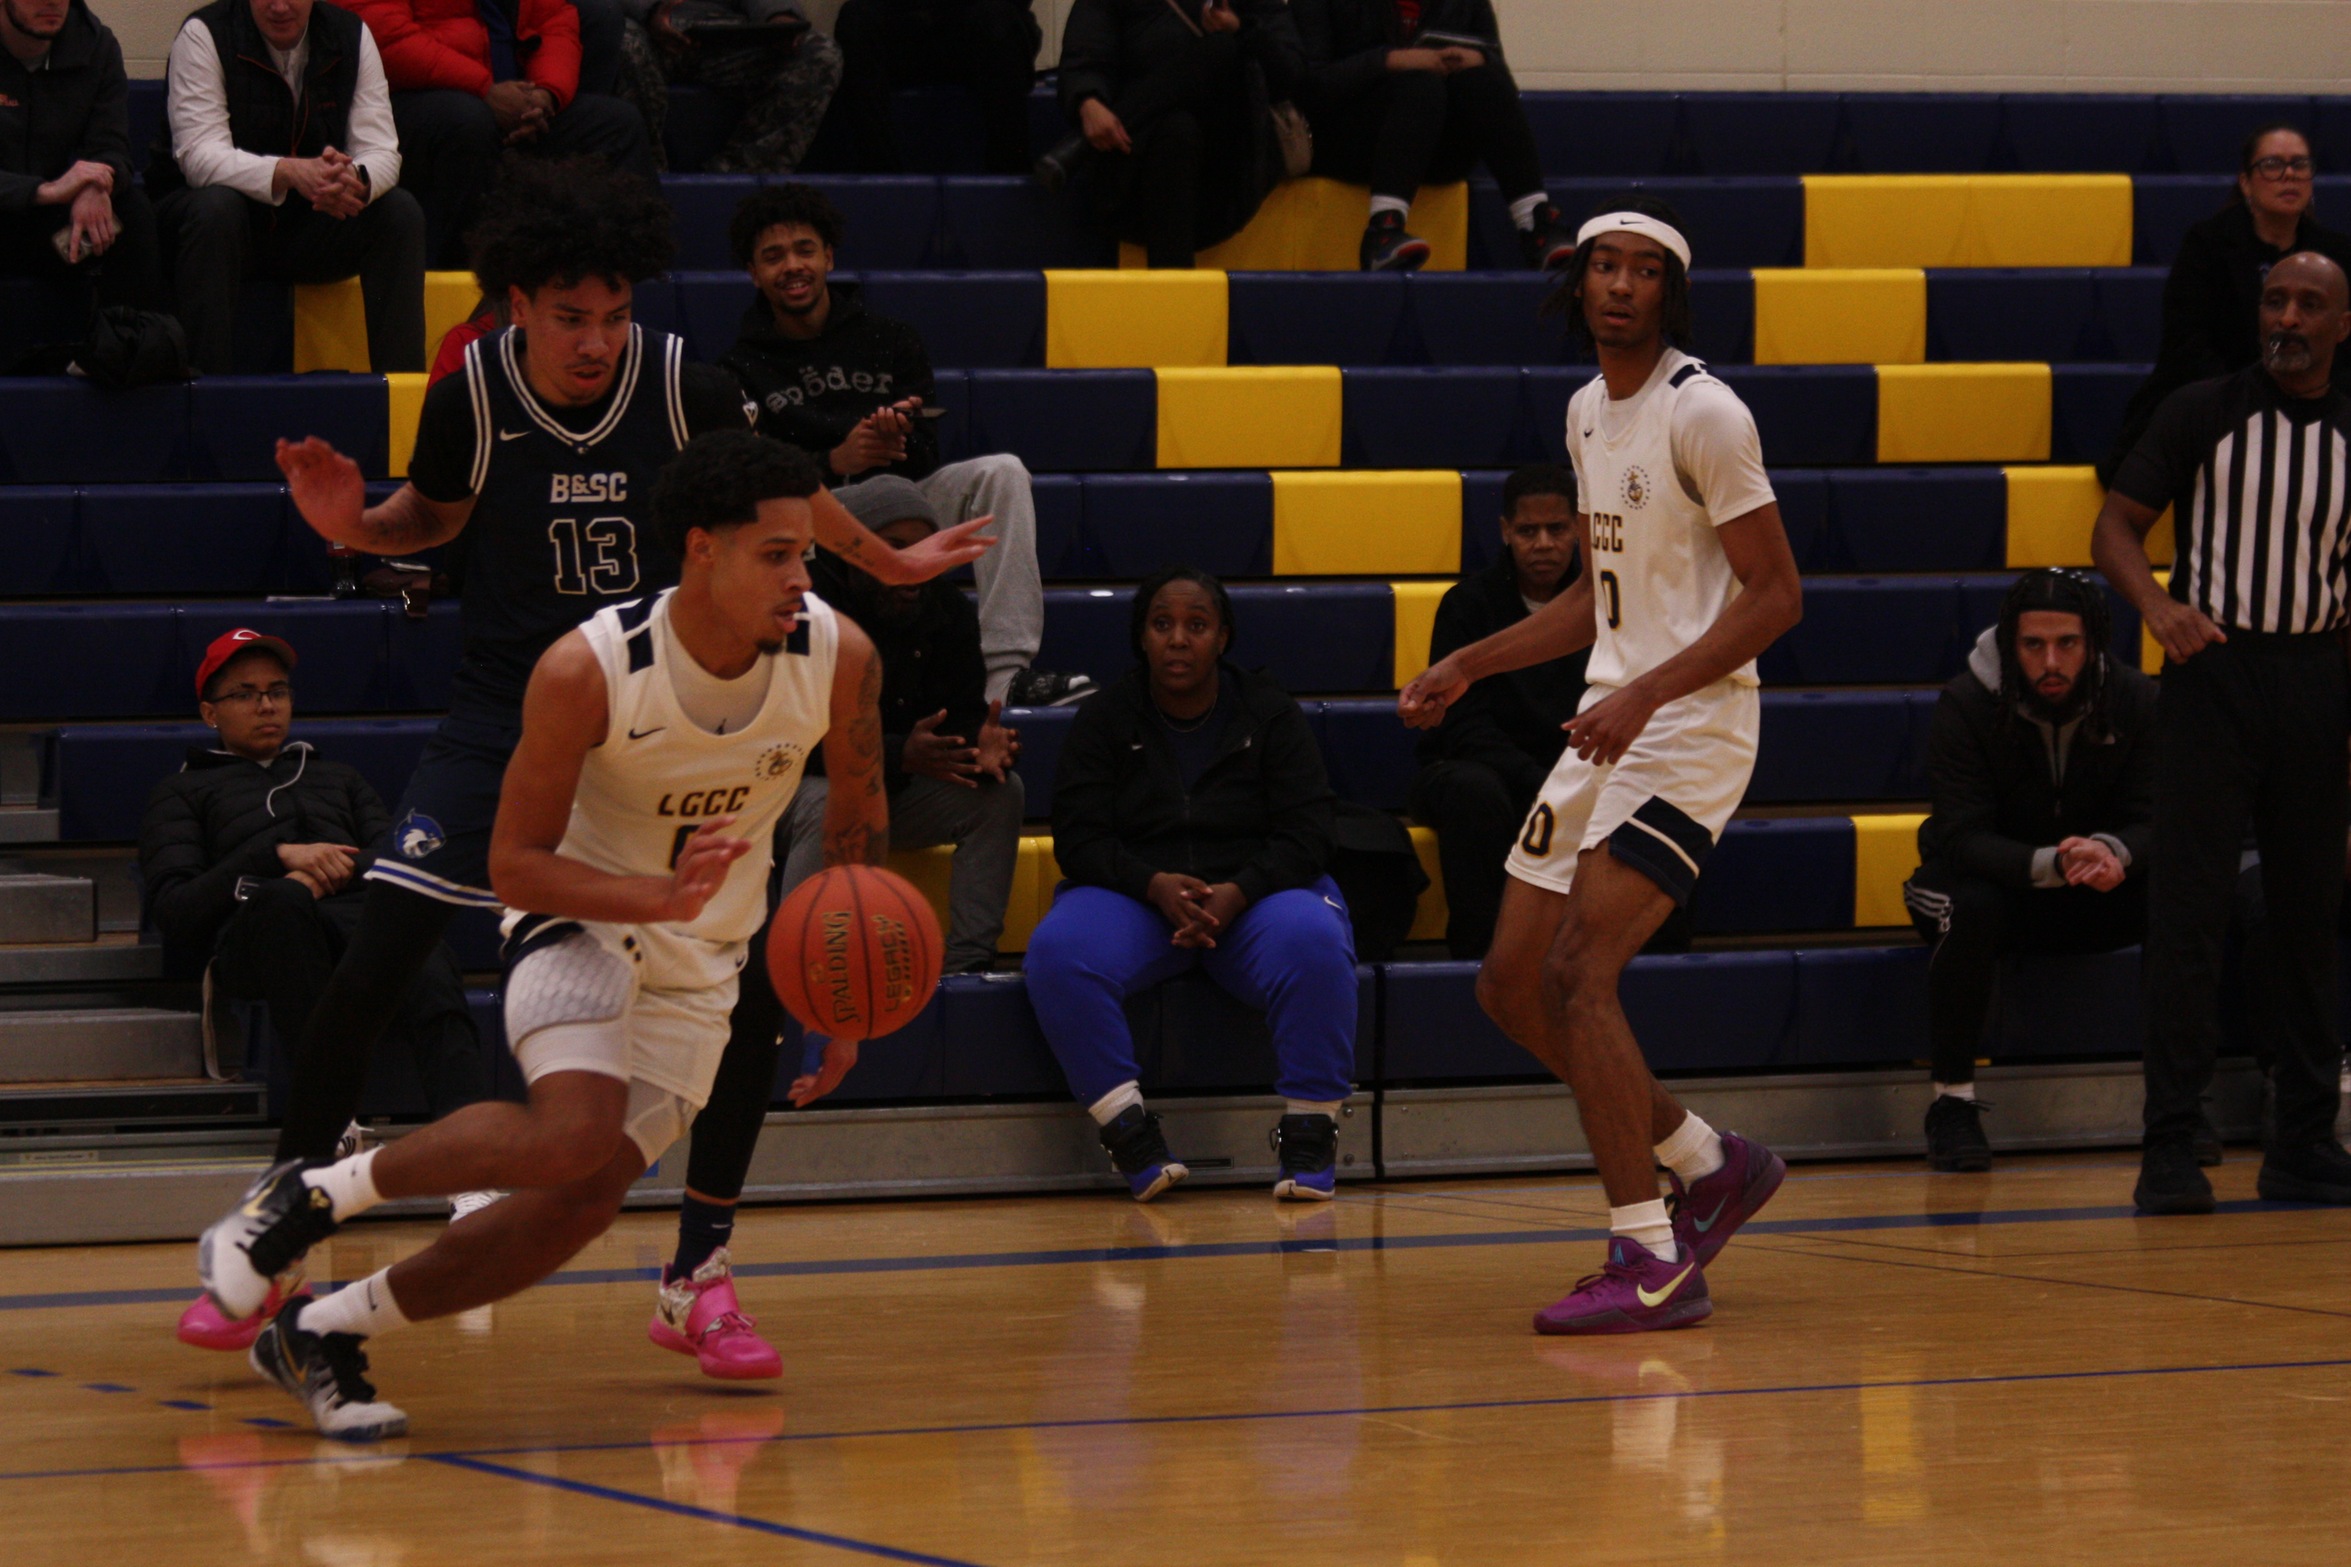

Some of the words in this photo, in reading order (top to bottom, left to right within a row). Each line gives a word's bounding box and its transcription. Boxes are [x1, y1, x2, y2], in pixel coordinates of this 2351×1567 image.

[549, 471, 629, 504] B&SC
[547, 516, 641, 595] 13
[1522, 800, 1555, 858] 0
[822, 911, 861, 1024] SPALDING
[869, 913, 902, 1013] LEGACY
